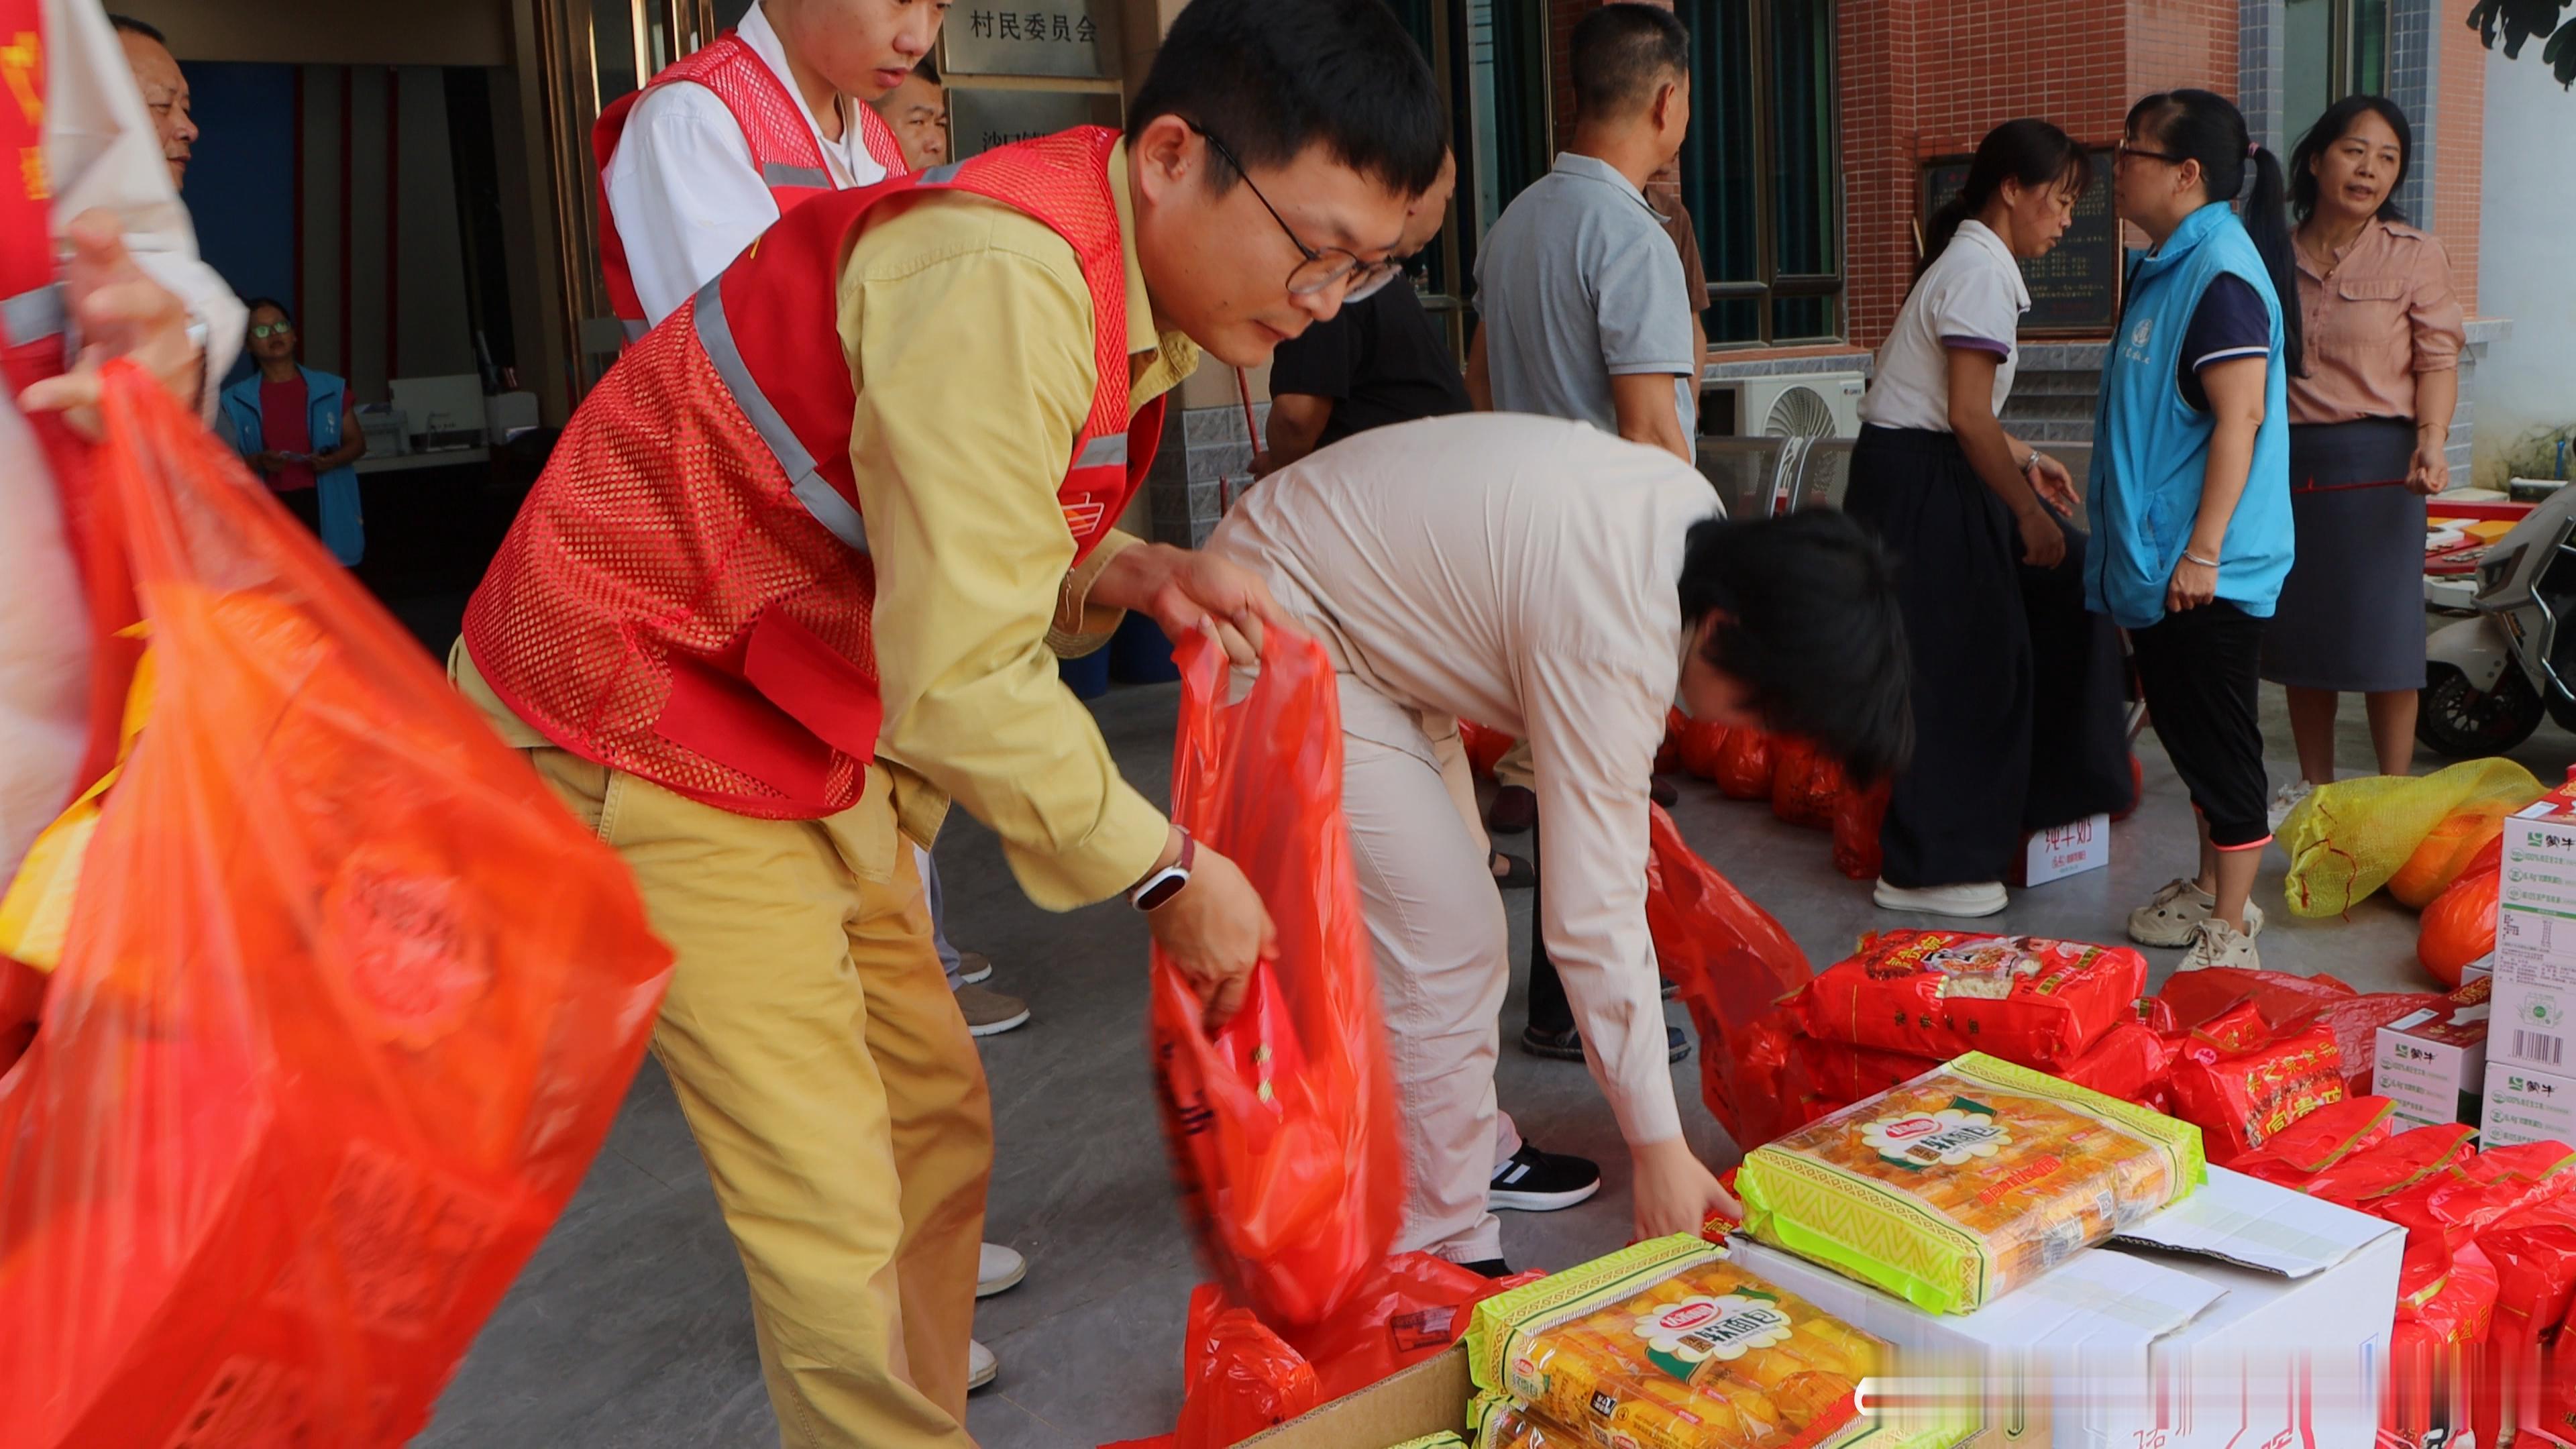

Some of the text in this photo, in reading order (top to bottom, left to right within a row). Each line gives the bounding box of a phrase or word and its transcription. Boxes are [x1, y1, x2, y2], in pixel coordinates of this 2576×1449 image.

[971, 11, 1096, 42] 村民委员会
[2546, 834, 2575, 851] 蒙牛
[2411, 1048, 2436, 1065] 蒙牛
[2526, 1080, 2555, 1097] 蒙牛
[1695, 1309, 1782, 1342] 软面包
